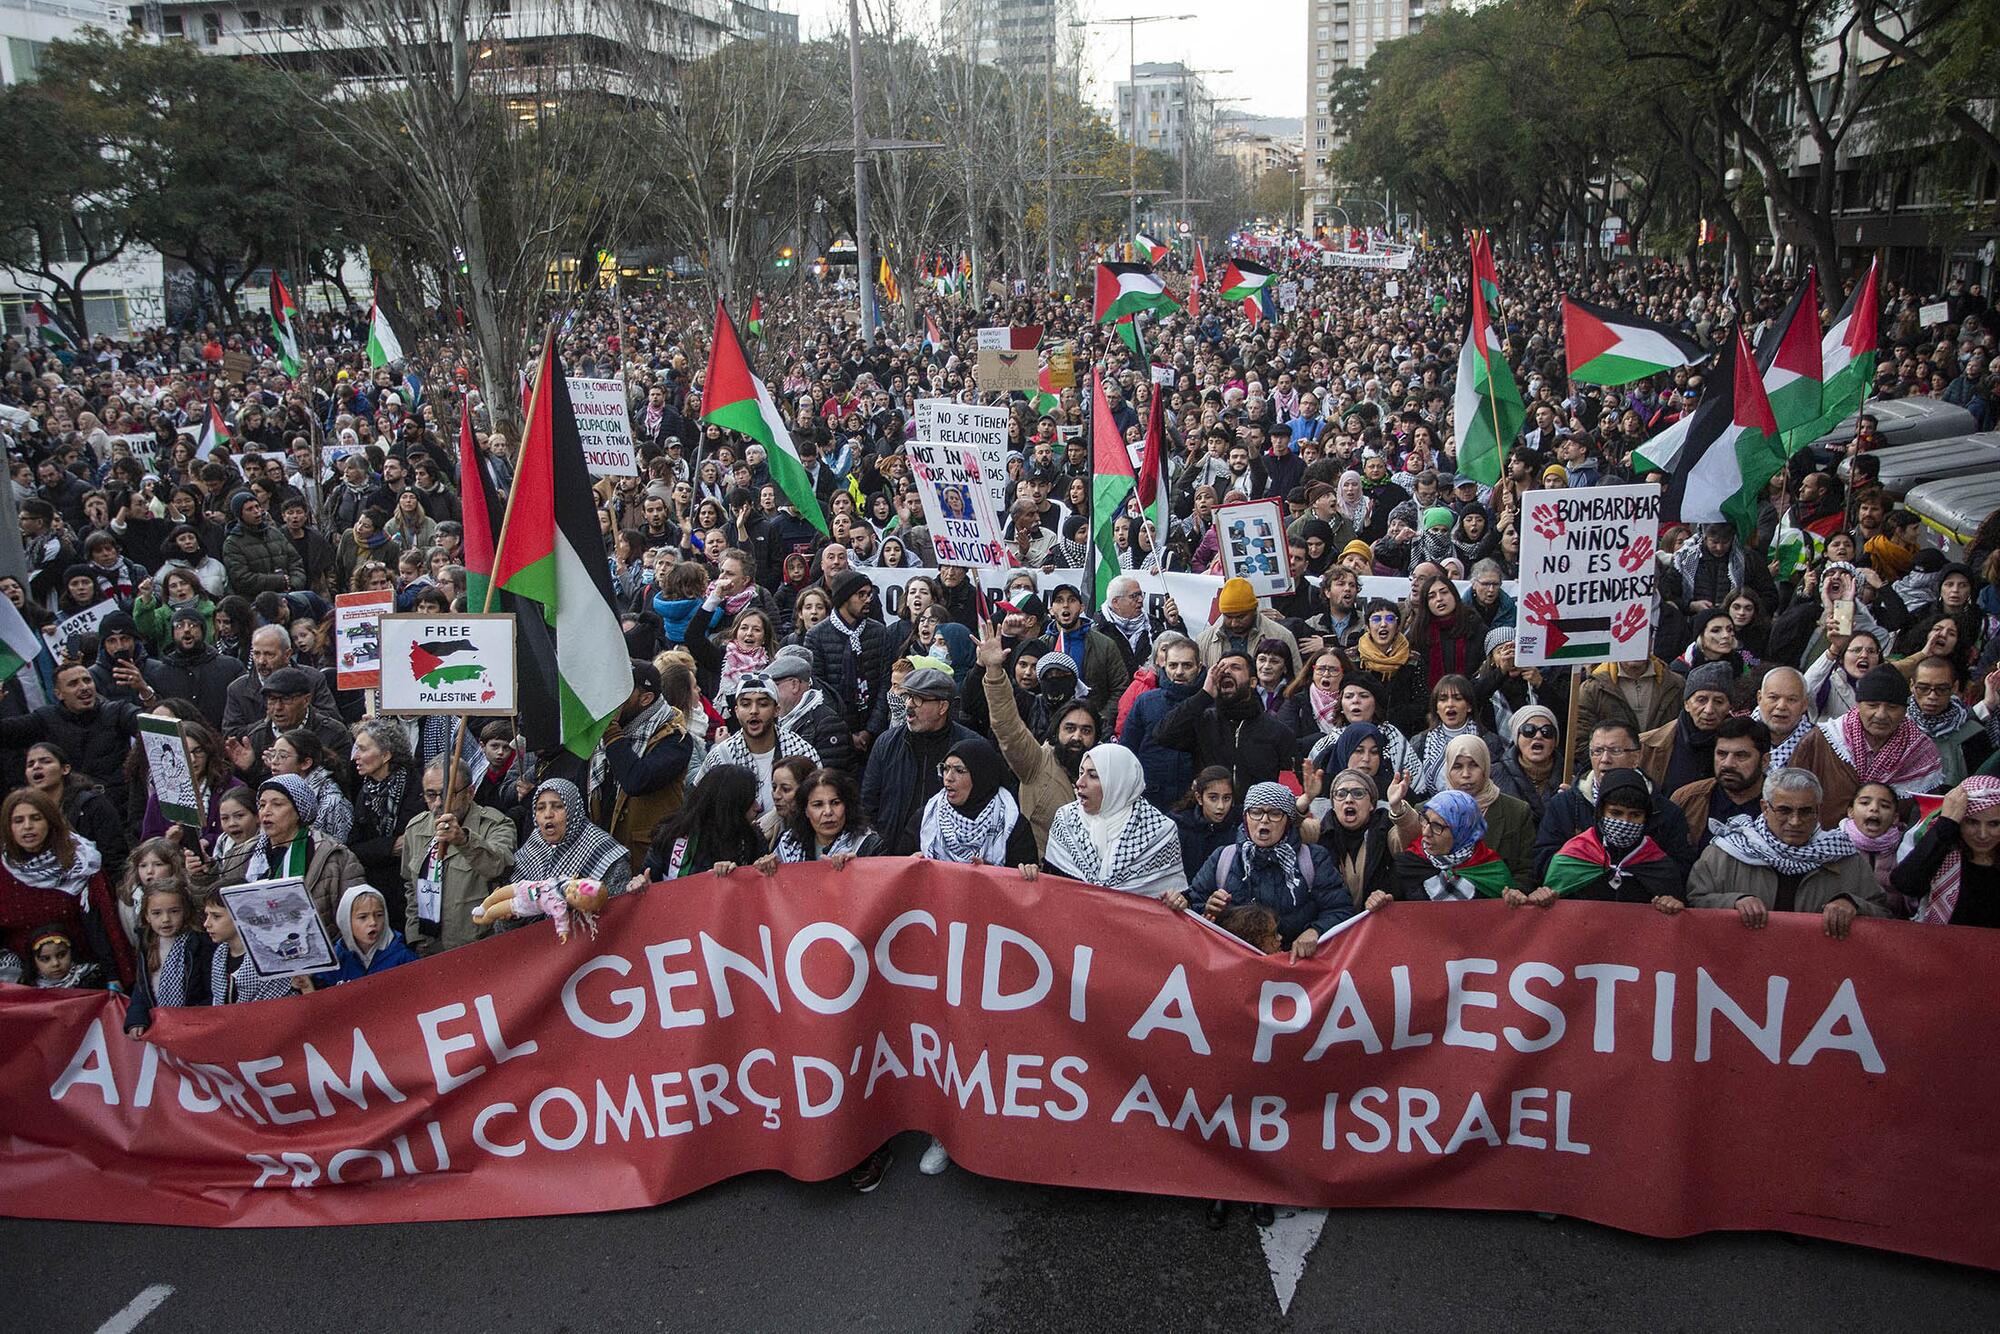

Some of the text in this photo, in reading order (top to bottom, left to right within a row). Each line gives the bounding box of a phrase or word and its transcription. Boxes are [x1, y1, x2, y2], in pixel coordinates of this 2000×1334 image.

[585, 391, 595, 399] ES
[592, 382, 623, 392] CONFLICTO
[572, 401, 624, 416] OLONIALISMO
[937, 411, 1008, 429] NO SE TIENEN
[940, 430, 1002, 445] RELACIONES
[584, 449, 630, 467] ENOCIDIO
[912, 446, 962, 466] NOT IN
[925, 467, 982, 485] OUR NAME
[1557, 495, 1661, 523] BOMBARDEAR
[946, 521, 980, 539] FRAU
[1567, 525, 1629, 551] NIÑOS
[935, 540, 1001, 566] GENOCIDE
[1543, 553, 1612, 574] NO ES
[1555, 575, 1655, 606] DEFENDERSE
[425, 626, 471, 637] FREE
[420, 692, 477, 702] PALESTINE
[417, 994, 539, 1094] EL
[561, 909, 1094, 1040] GENOCIDI
[1128, 963, 1212, 1056] A
[1252, 957, 1887, 1075] PALESTINA
[471, 1048, 782, 1157] COMERÇ
[793, 1022, 1090, 1122] D'ARMES
[1111, 1073, 1290, 1152] AMB
[1322, 1087, 1591, 1155] ISRAEL
